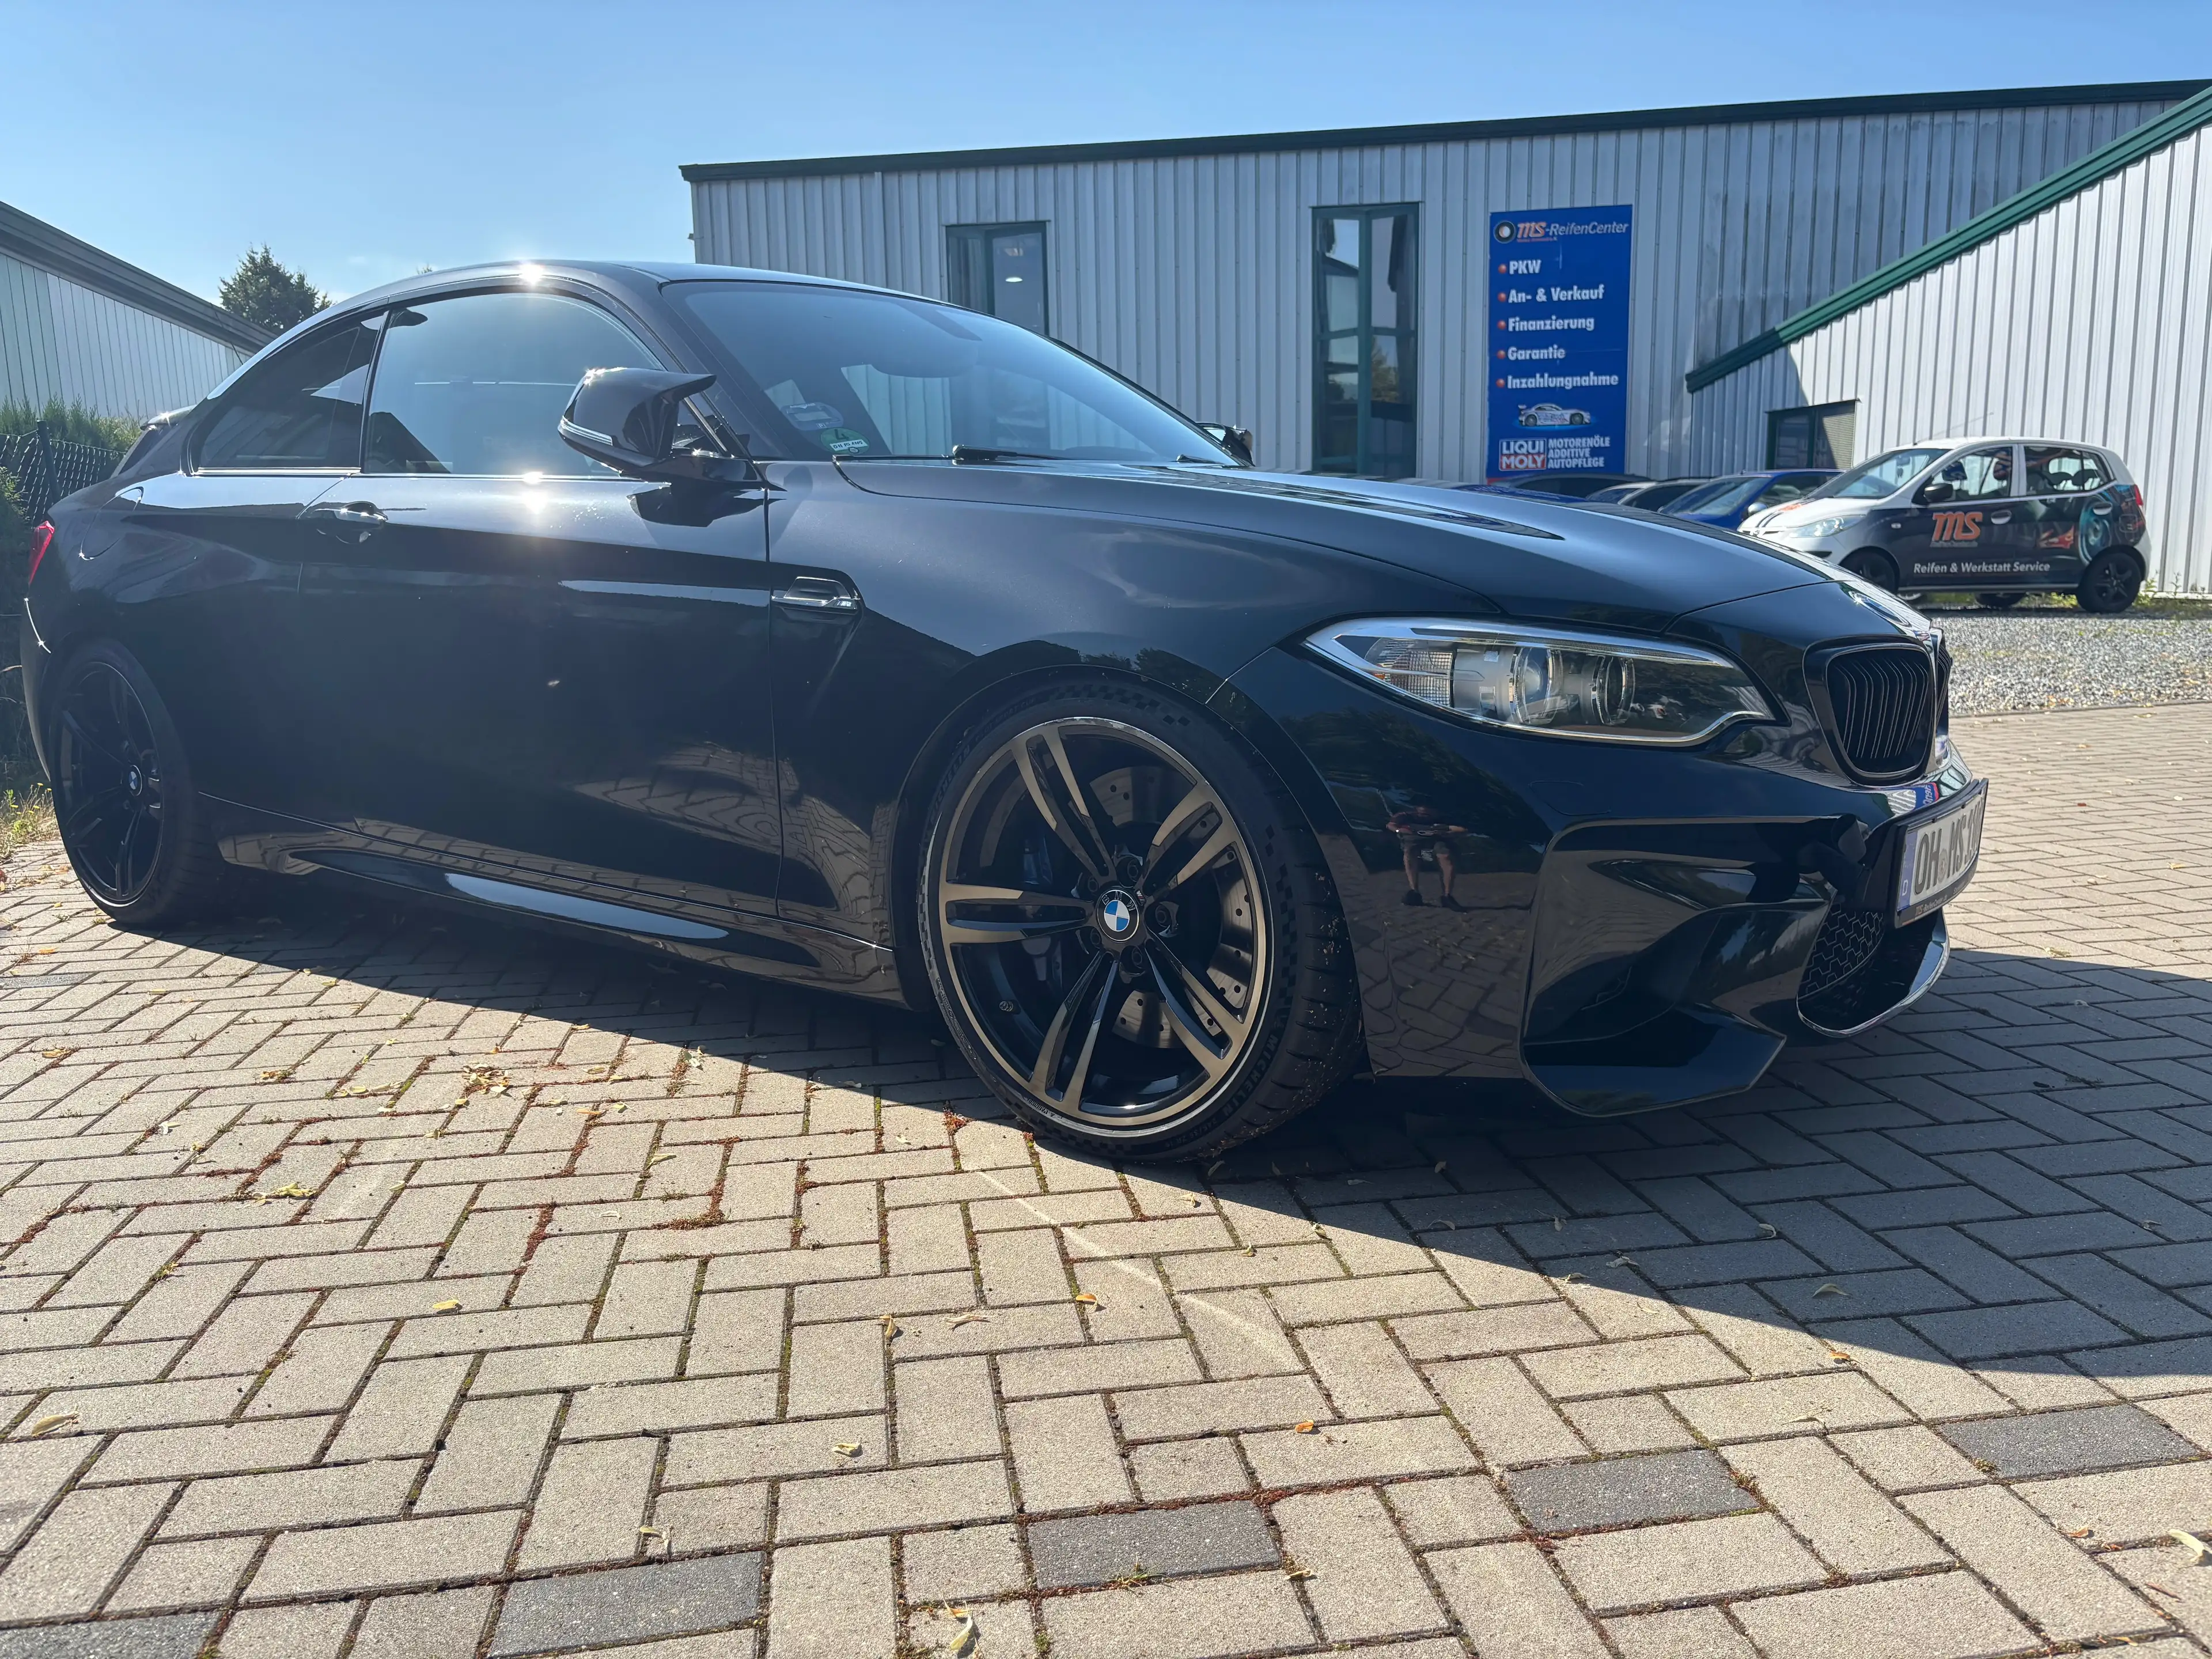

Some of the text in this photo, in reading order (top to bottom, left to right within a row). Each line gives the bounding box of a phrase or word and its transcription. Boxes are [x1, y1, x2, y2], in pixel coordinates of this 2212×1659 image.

[1509, 259, 1541, 275] PKW
[1508, 283, 1605, 303] An- & Verkauf
[1508, 315, 1595, 332] Finanzierung
[1508, 343, 1566, 361] Garantie
[1507, 370, 1619, 389] Inzahlungnahme
[1502, 440, 1544, 454] LIQUI
[1548, 435, 1611, 449] MOTORENÖLE
[1502, 454, 1545, 469] MOLY
[1547, 448, 1590, 459] ADDITIVE
[1547, 457, 1605, 469] AUTOPFLEGE
[1932, 511, 1983, 541] MS
[1913, 560, 2051, 574] Reifen & Werkstatt Service
[1914, 828, 1942, 895] OH
[1902, 879, 1908, 896] D
[1101, 891, 1136, 911] BMW
[1222, 1033, 1279, 1116] MICHELIN
